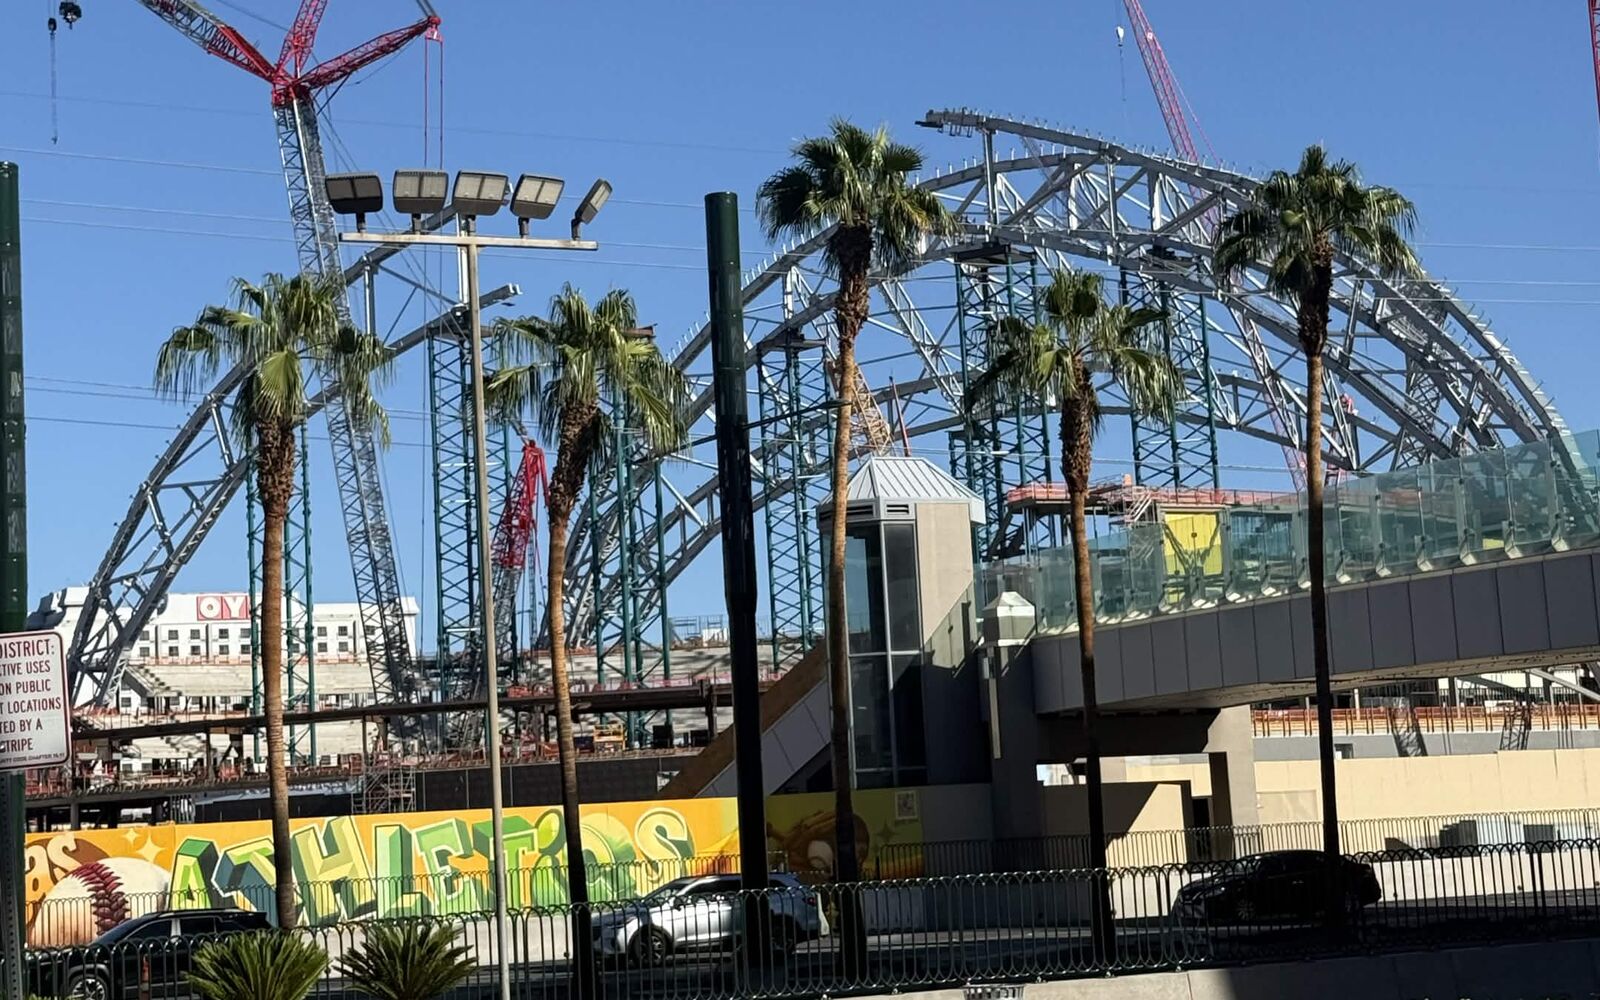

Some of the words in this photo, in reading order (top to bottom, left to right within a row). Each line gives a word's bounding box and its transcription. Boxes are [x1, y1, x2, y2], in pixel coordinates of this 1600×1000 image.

[26, 660, 51, 674] USES
[0, 682, 12, 696] ON
[16, 679, 51, 694] PUBLIC
[8, 697, 61, 714] LOCATIONS
[20, 719, 32, 732] BY
[36, 717, 43, 730] A
